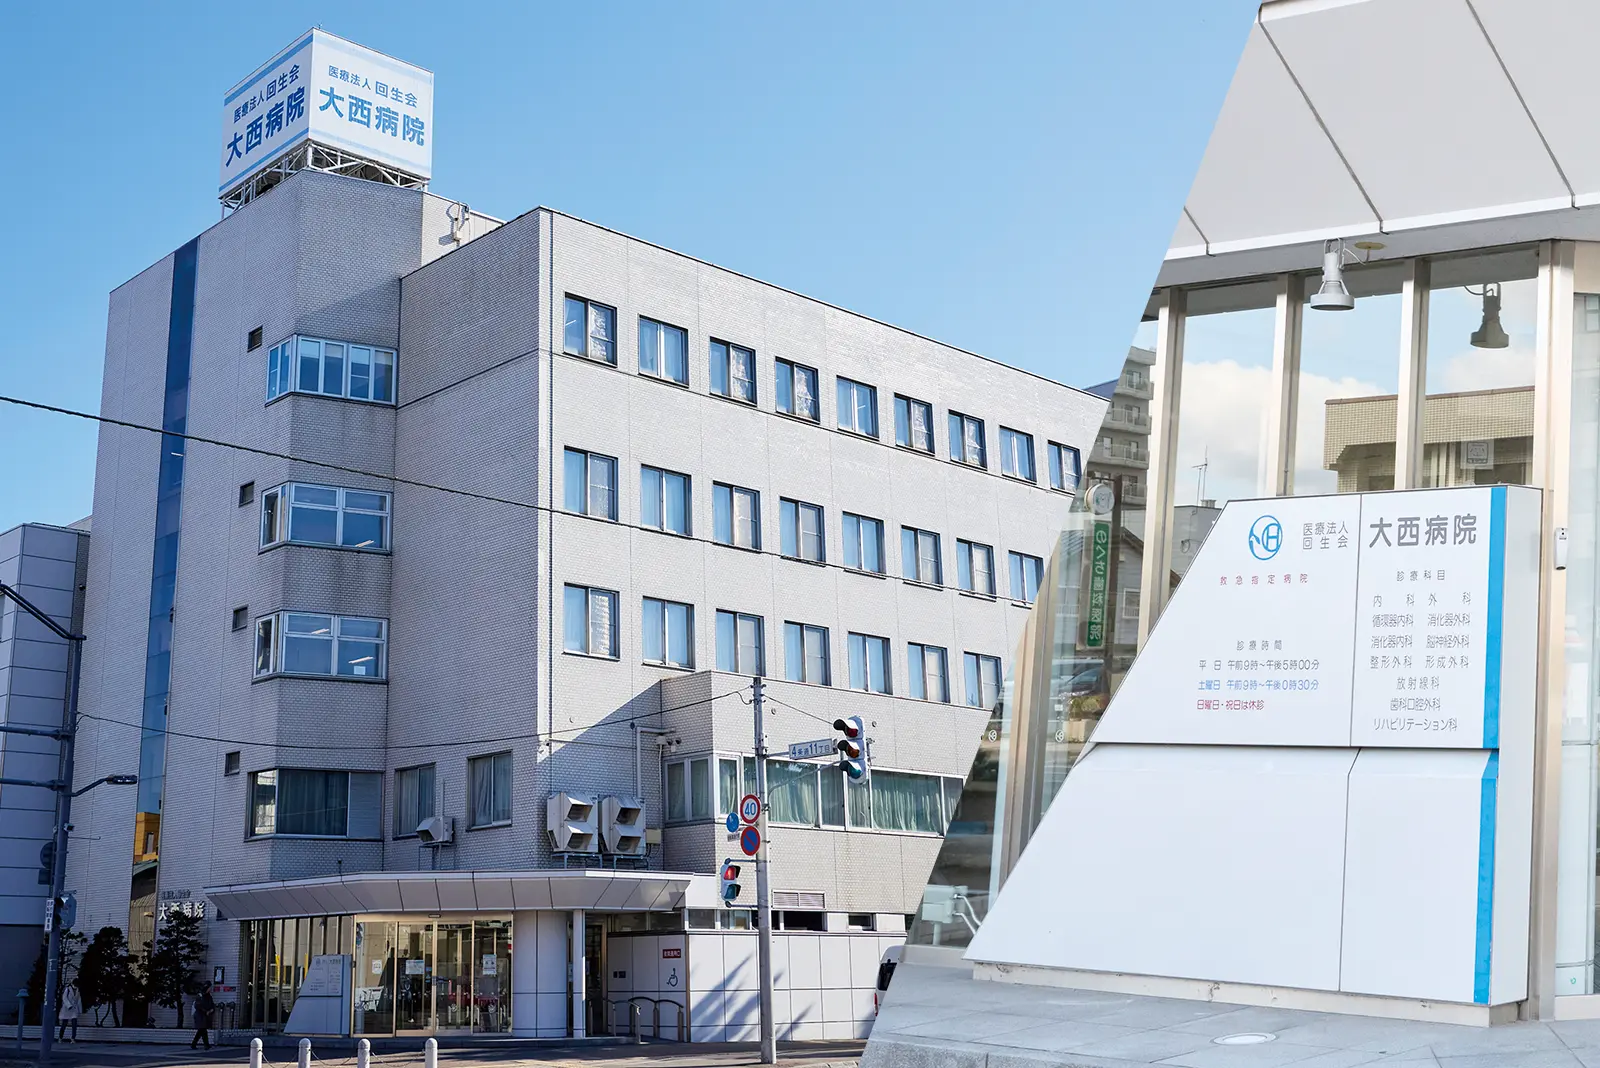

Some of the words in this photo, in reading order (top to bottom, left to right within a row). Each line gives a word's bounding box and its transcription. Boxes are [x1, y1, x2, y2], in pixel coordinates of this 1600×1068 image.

[319, 86, 425, 147] 大西病院
[225, 86, 306, 167] 大西病院
[1303, 521, 1348, 536] 医療法人
[1369, 513, 1477, 548] 大西病院
[1303, 535, 1348, 550] 回生会
[1220, 574, 1308, 585] 救急指定病院
[1397, 570, 1445, 581] 診療科目
[1372, 614, 1414, 628] 循環器内科
[1428, 613, 1470, 628] 消化器外科
[1237, 640, 1282, 650] 診療時間
[1371, 635, 1412, 648] 消化器内科
[1426, 634, 1469, 648] 脳神経外科
[1370, 655, 1412, 669] 整形外科
[1425, 655, 1469, 668] 形成外科
[1396, 676, 1439, 690] 放射線科
[1390, 697, 1440, 711] 歯科口腔外科
[1374, 717, 1457, 732] リハビリテーション科
[744, 802, 757, 816] 40
